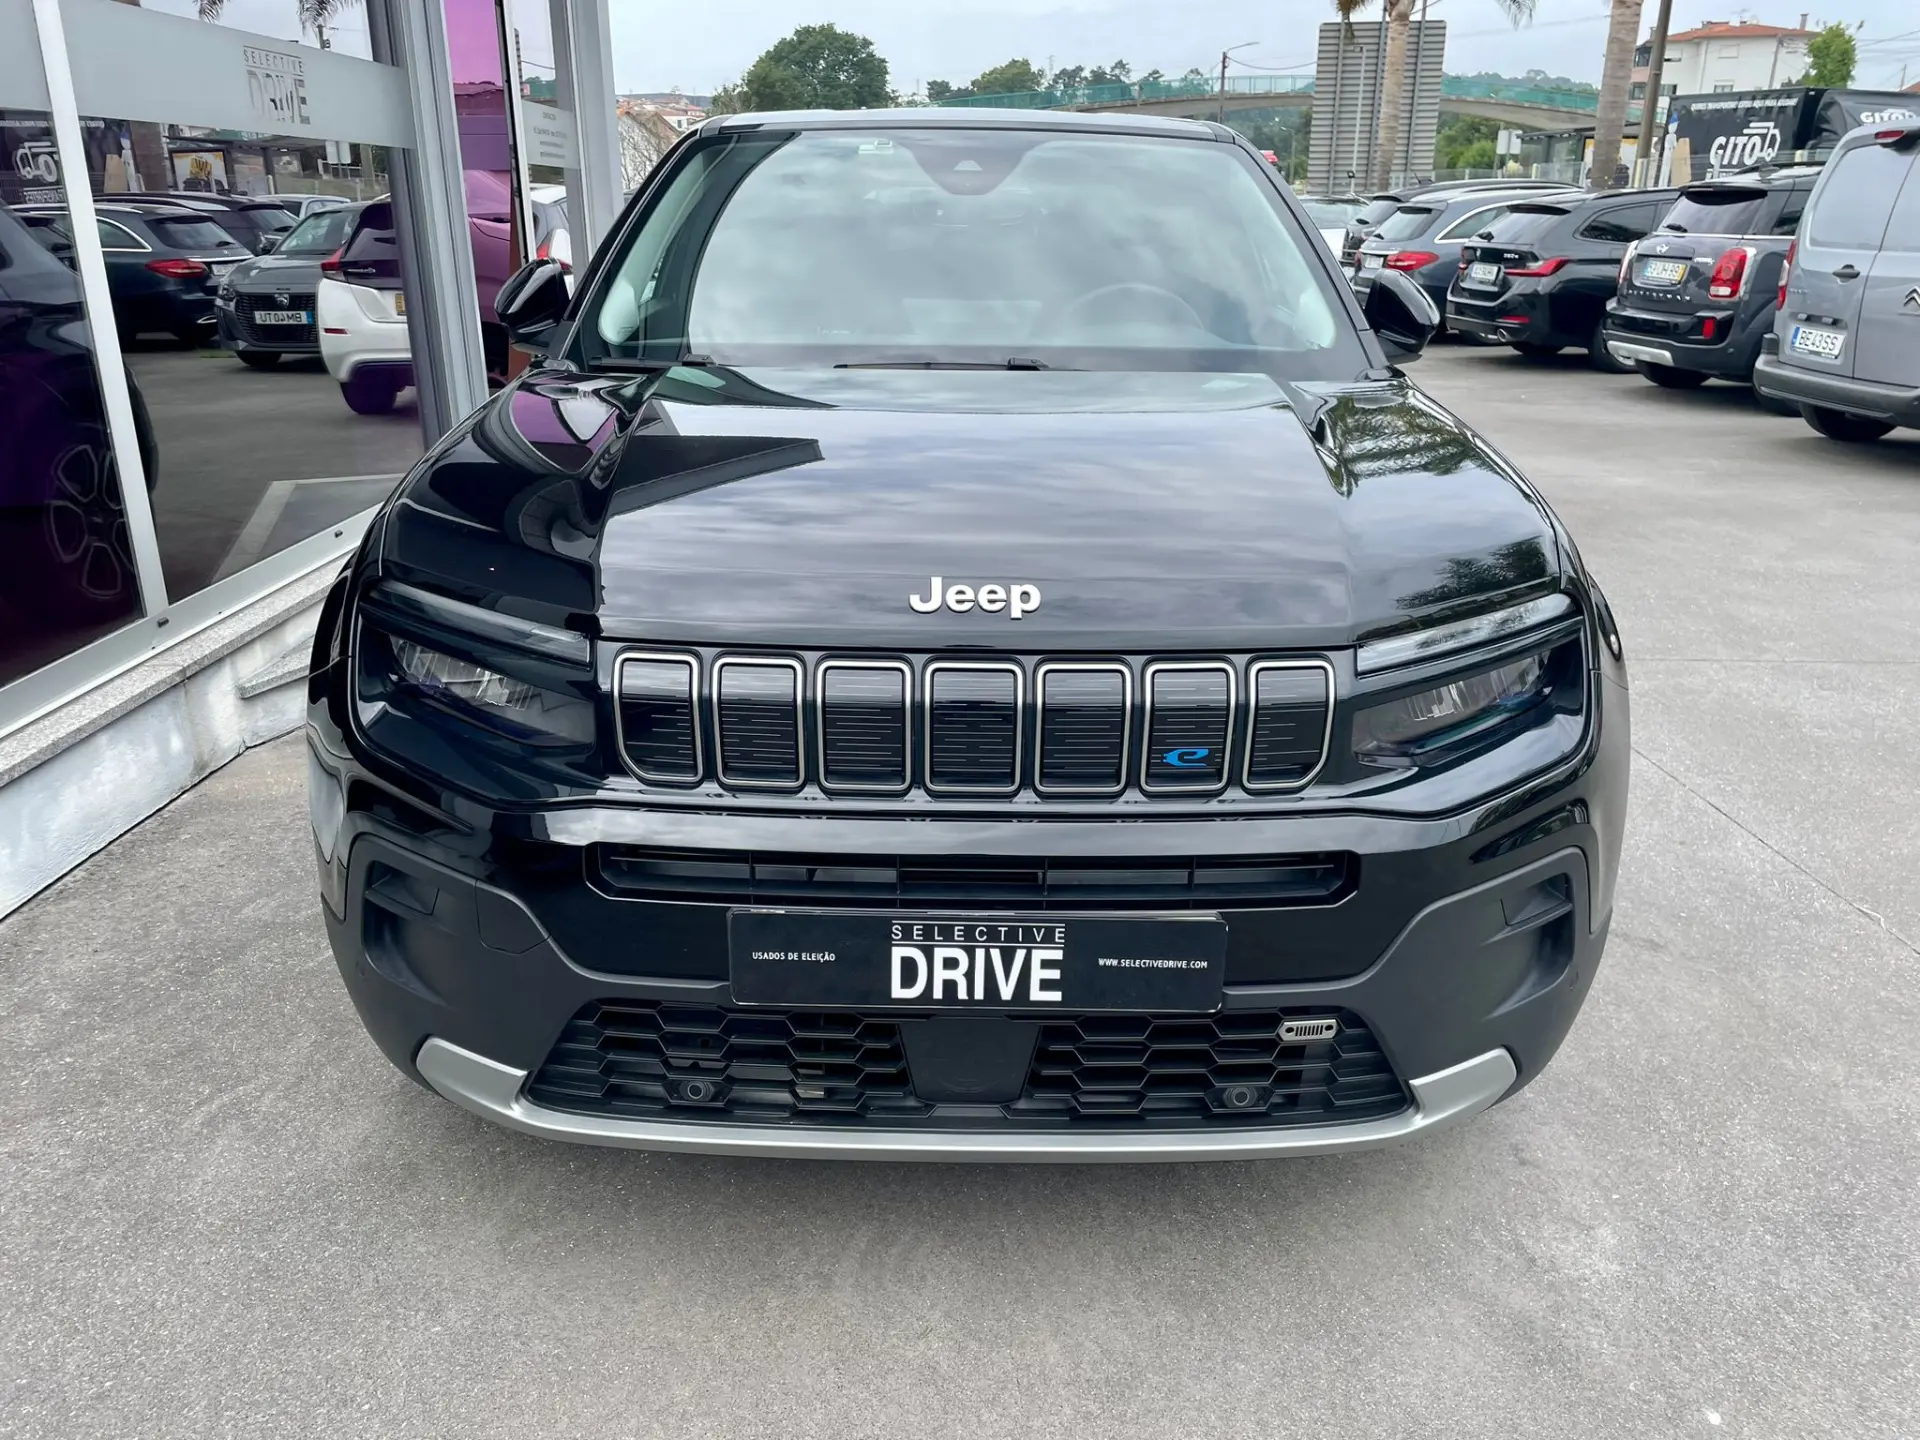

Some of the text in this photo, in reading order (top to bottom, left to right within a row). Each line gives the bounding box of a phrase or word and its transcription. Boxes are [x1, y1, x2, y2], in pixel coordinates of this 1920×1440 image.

[244, 49, 304, 74] SELECTIVE
[1709, 135, 1762, 167] GITO
[909, 576, 1042, 621] Jeep
[891, 924, 1066, 943] SELECTIVE
[751, 951, 837, 963] USADOS DE ELEIÇÃO
[1097, 957, 1209, 970] WWW.SELECTIVEDRIVE.COM
[890, 946, 1064, 1002] DRIVE
